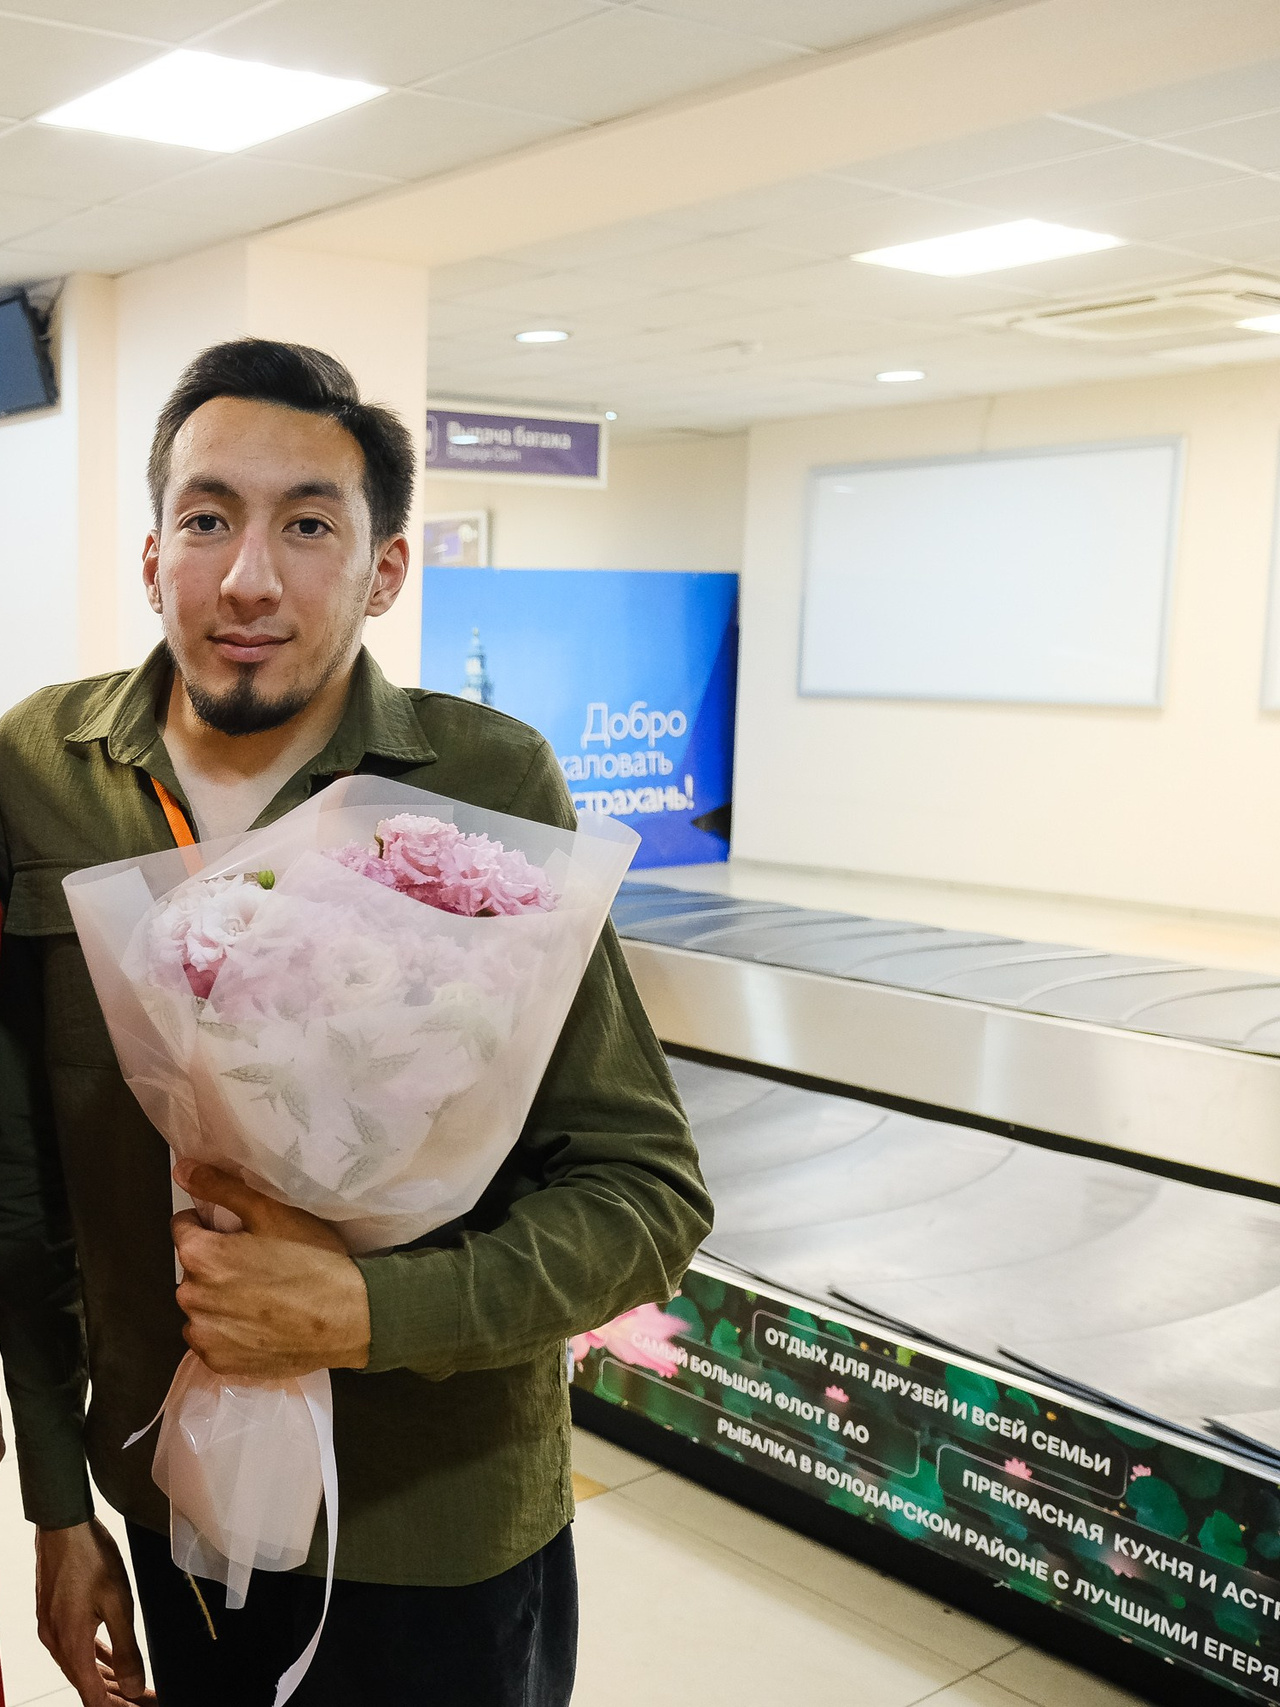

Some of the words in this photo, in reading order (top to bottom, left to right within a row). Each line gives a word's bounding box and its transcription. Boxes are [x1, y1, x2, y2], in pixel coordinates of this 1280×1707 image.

[580, 700, 688, 750] Добро
[631, 1331, 688, 1368] САМЫЙ
[690, 1355, 772, 1404] БОЛЬШОЙ
[774, 1391, 825, 1425] ФЛОТ
[827, 1412, 840, 1432] В
[843, 1420, 870, 1444] АО
[764, 1327, 829, 1366] ОТДЫХ
[829, 1353, 870, 1382] ДЛЯ
[871, 1368, 949, 1413] ДРУЗЕЙ
[952, 1398, 968, 1421] И
[971, 1405, 1027, 1444] ВСЕЙ
[1031, 1430, 1112, 1477] СЕМЬИ
[717, 1417, 797, 1467] РЫБАЛКА
[799, 1453, 812, 1474] В
[814, 1461, 961, 1541] ВОЛОДАРСКОМ
[965, 1528, 1049, 1582] РАЙОНЕ
[1053, 1569, 1070, 1590] С
[1073, 1578, 1198, 1650] ЛУЧШИМИ
[962, 1469, 1104, 1545] ПРЕКРАСНАЯ
[1114, 1532, 1194, 1583] КУХНЯ
[1199, 1569, 1217, 1593] И
